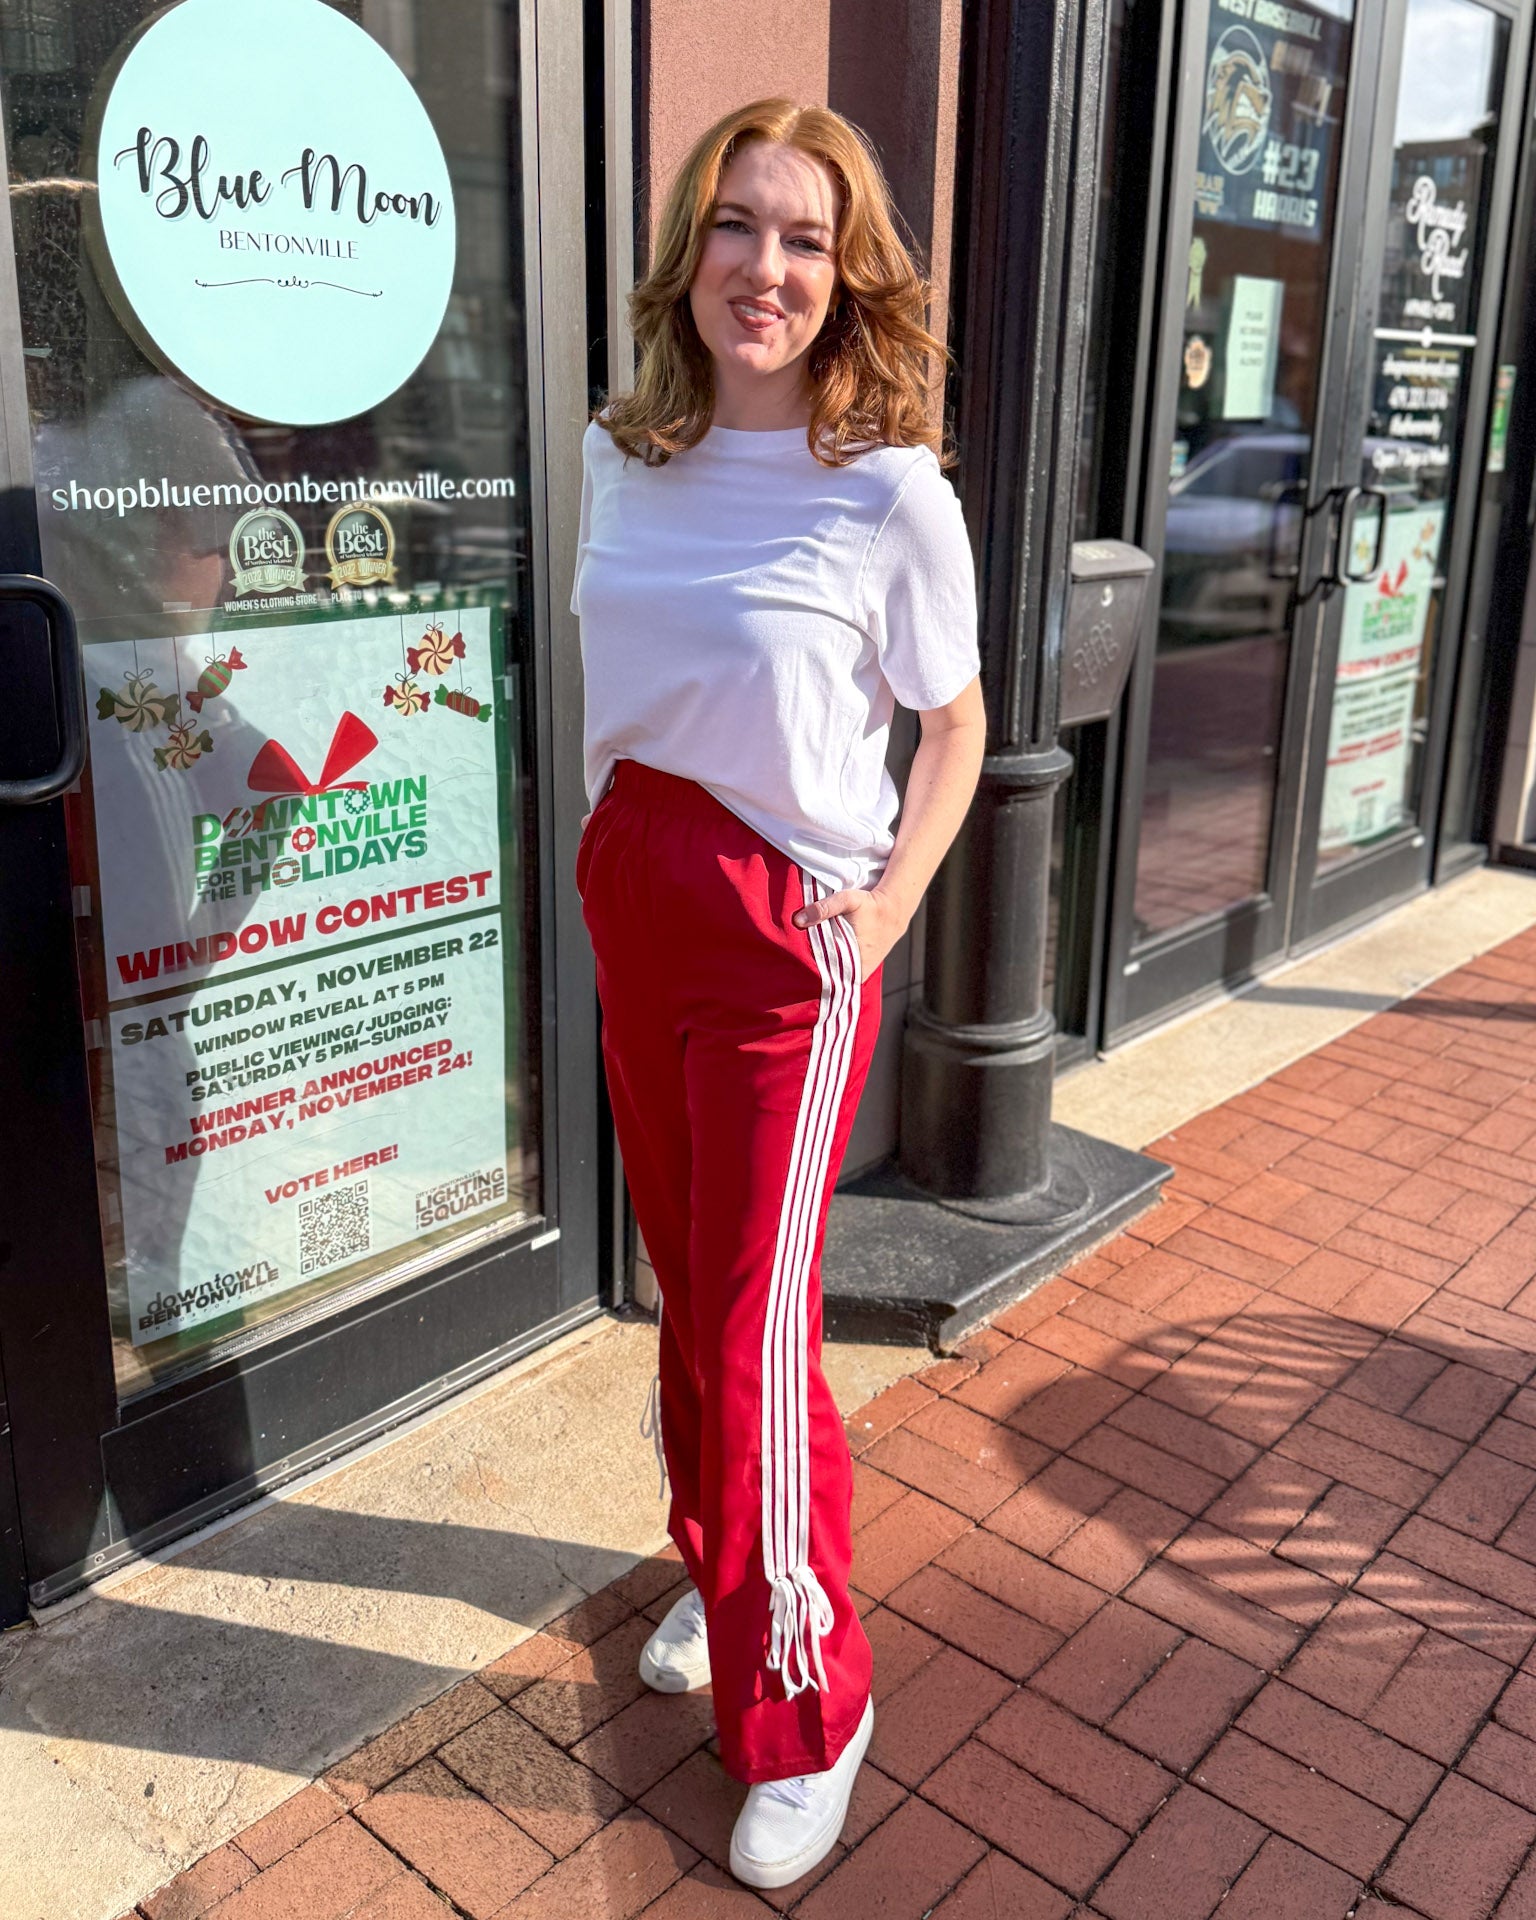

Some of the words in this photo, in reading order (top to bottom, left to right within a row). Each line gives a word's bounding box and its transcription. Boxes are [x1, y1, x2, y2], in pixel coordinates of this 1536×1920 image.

[114, 127, 271, 219] Blue
[281, 148, 440, 226] Moon
[1262, 140, 1319, 191] #23
[1253, 190, 1318, 227] HARRIS
[219, 229, 360, 260] BENTONVILLE
[52, 473, 516, 517] shopbluemoonbentonville.com
[241, 535, 293, 561] Best
[258, 527, 276, 541] the
[337, 528, 385, 554] Best
[352, 522, 369, 535] the
[243, 571, 263, 585] 2022
[264, 568, 296, 582] WINNER
[338, 563, 356, 578] 2022
[358, 560, 387, 576] WINNER
[224, 599, 260, 612] WOMEN'S
[261, 596, 295, 609] CLOTHING
[295, 592, 318, 605] STORE
[192, 774, 427, 845] DOWNTOWN
[194, 803, 427, 873] BENTONVILLE
[241, 829, 428, 896] HOLIDAYS
[196, 870, 236, 890] FOR
[197, 884, 237, 904] THE
[116, 912, 307, 985] WINDOW
[315, 870, 492, 935] CONTEST
[120, 980, 307, 1046] SATURDAY,
[317, 937, 464, 993] NOVEMBER
[468, 928, 499, 952] 22
[194, 1017, 286, 1056] WINDOW
[290, 995, 369, 1029] REVEAL
[373, 985, 400, 1004] AT
[403, 981, 415, 995] 5
[418, 973, 445, 992] PM
[186, 1051, 265, 1087] PUBLIC
[268, 996, 452, 1060] VIEWING/JUDGING:
[189, 1087, 297, 1135] WINNER
[301, 1038, 453, 1098] ANNOUNCED
[191, 1052, 311, 1102] SATURDAY
[315, 1048, 327, 1063] 5
[165, 1110, 294, 1165] MONDAY,
[298, 1064, 433, 1121] NOVEMBER
[437, 1050, 473, 1076] 24!
[264, 1169, 329, 1205] VOTE
[333, 1143, 399, 1181] HERE!
[416, 1167, 504, 1213] LIGHTING
[420, 1181, 505, 1228] SQUARE
[139, 1267, 279, 1331] BENTONVILLE
[147, 1260, 271, 1315] downtown
